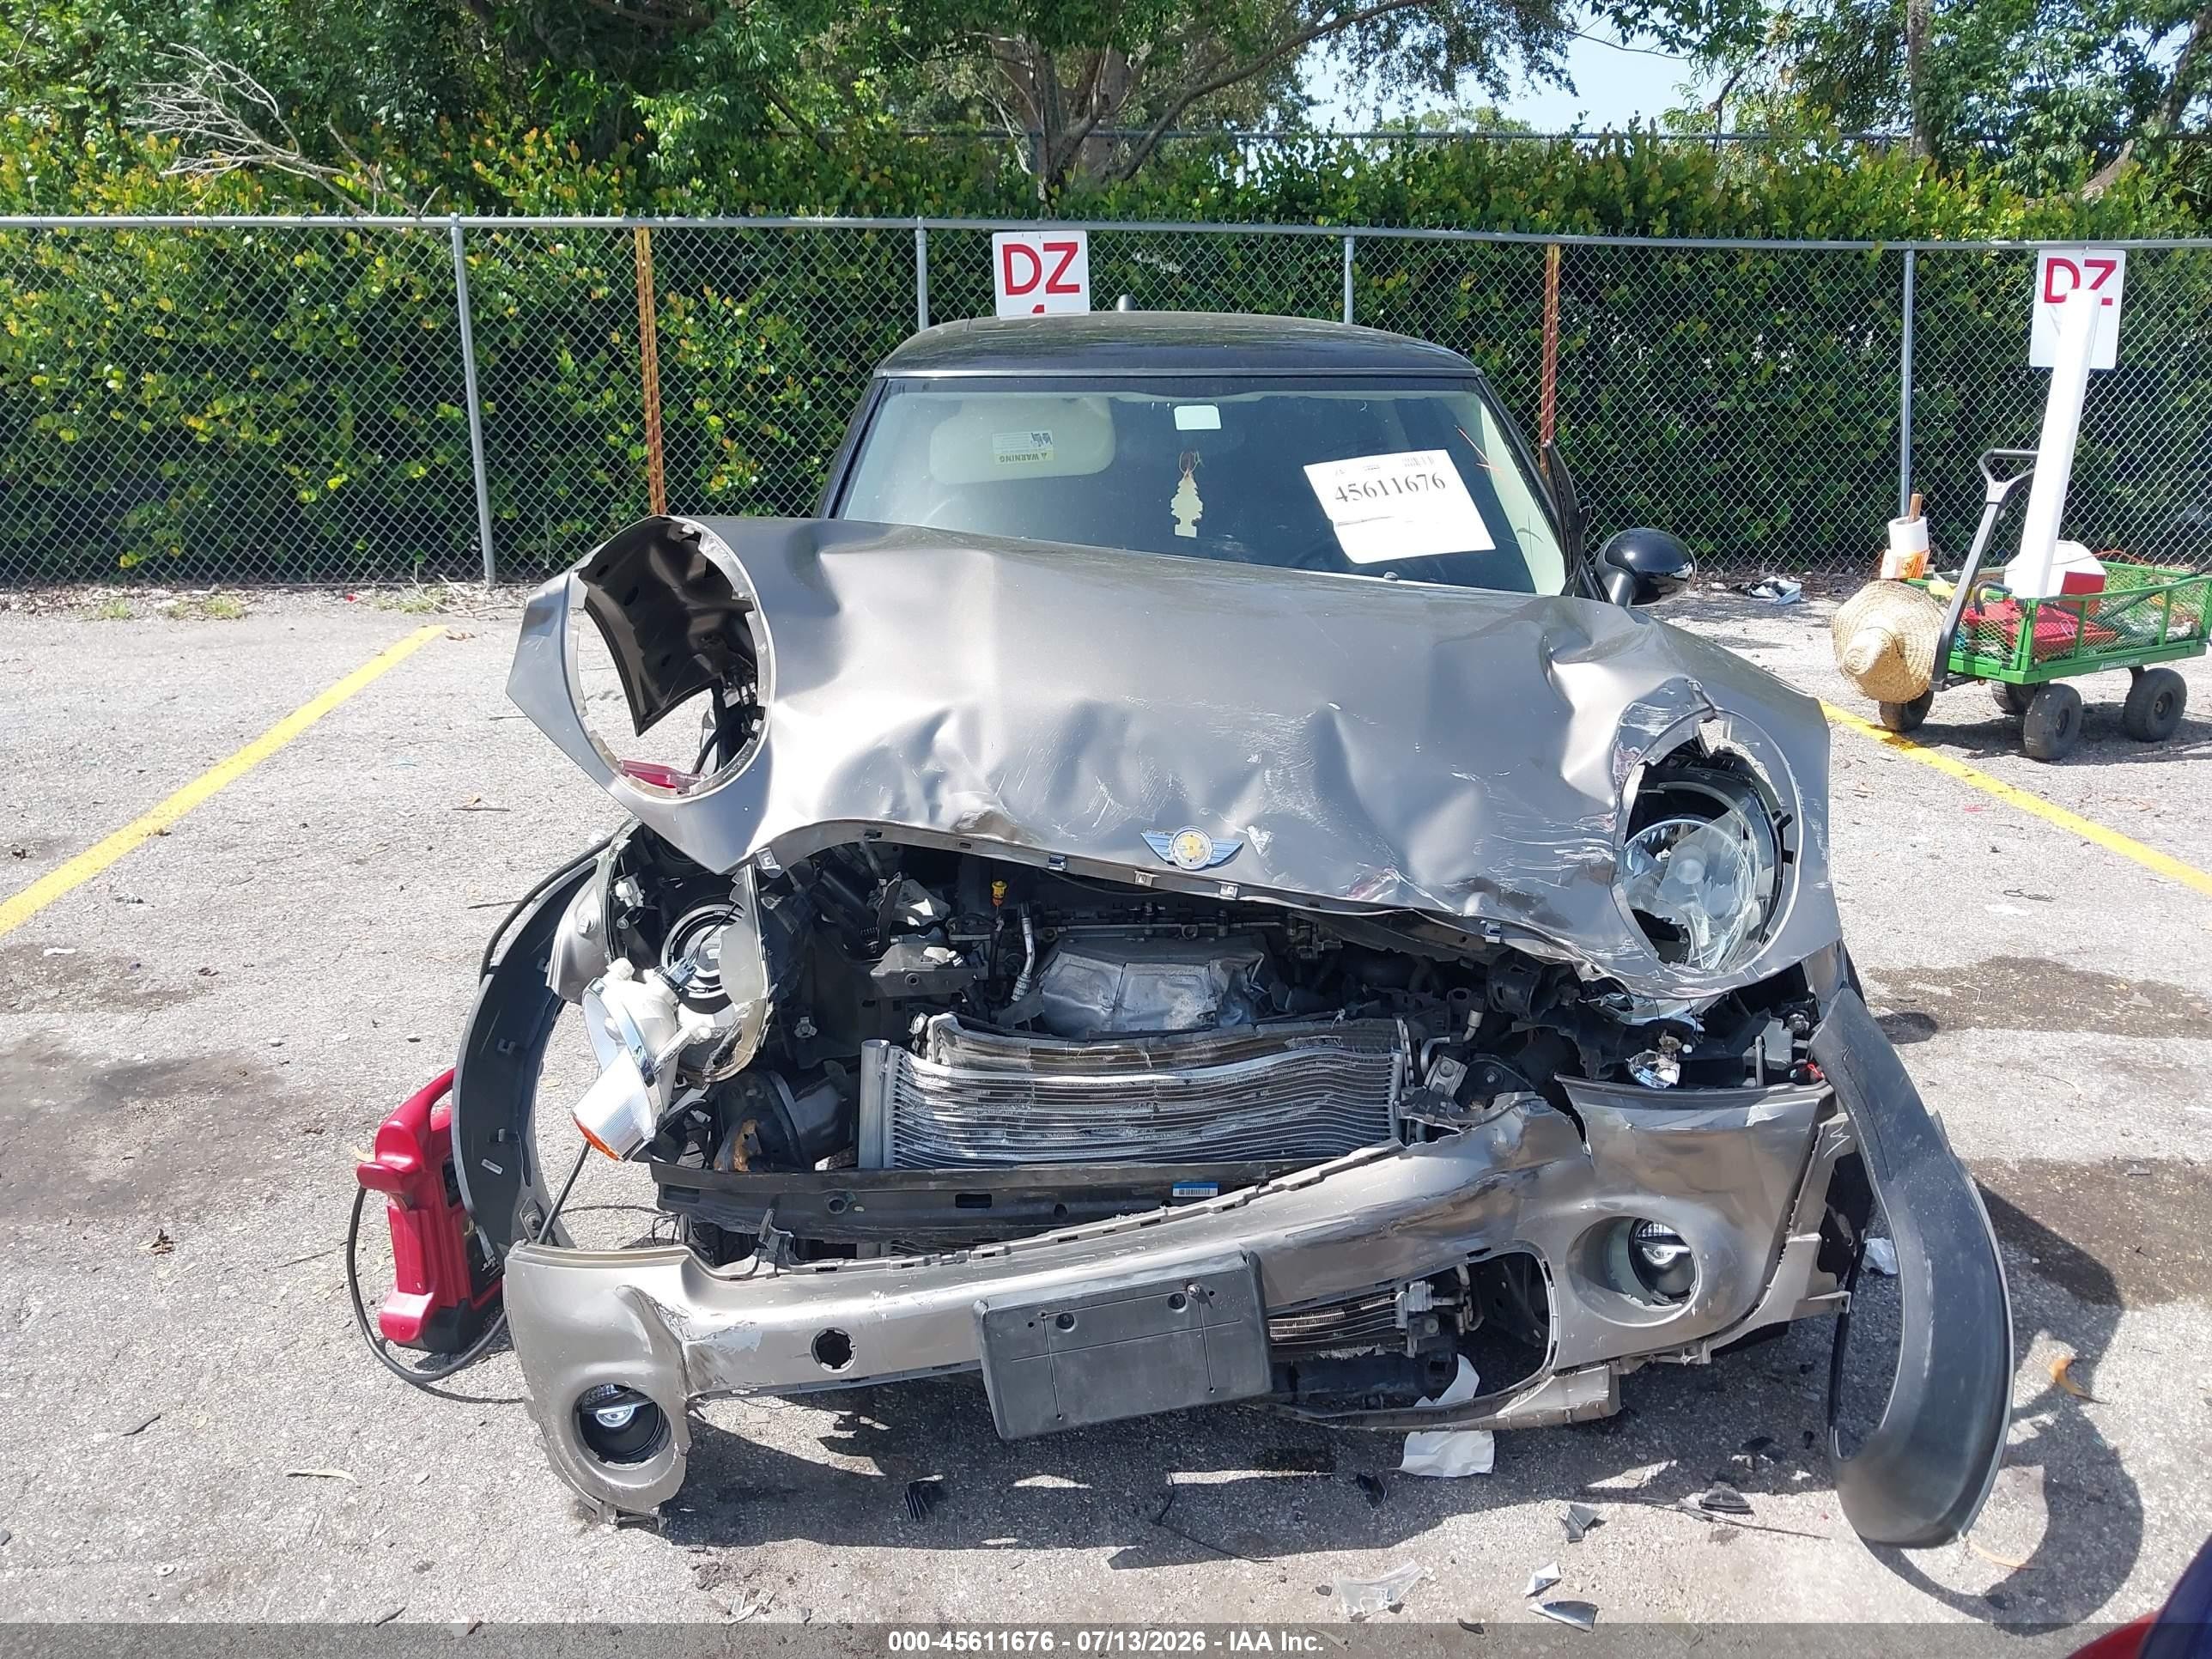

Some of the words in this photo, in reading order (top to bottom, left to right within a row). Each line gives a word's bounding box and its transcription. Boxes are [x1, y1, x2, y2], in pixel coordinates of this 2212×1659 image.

[1002, 241, 1080, 296] DZ
[2044, 257, 2118, 306] DZ
[999, 452, 1040, 463] WARNING
[1334, 472, 1446, 502] 45611676
